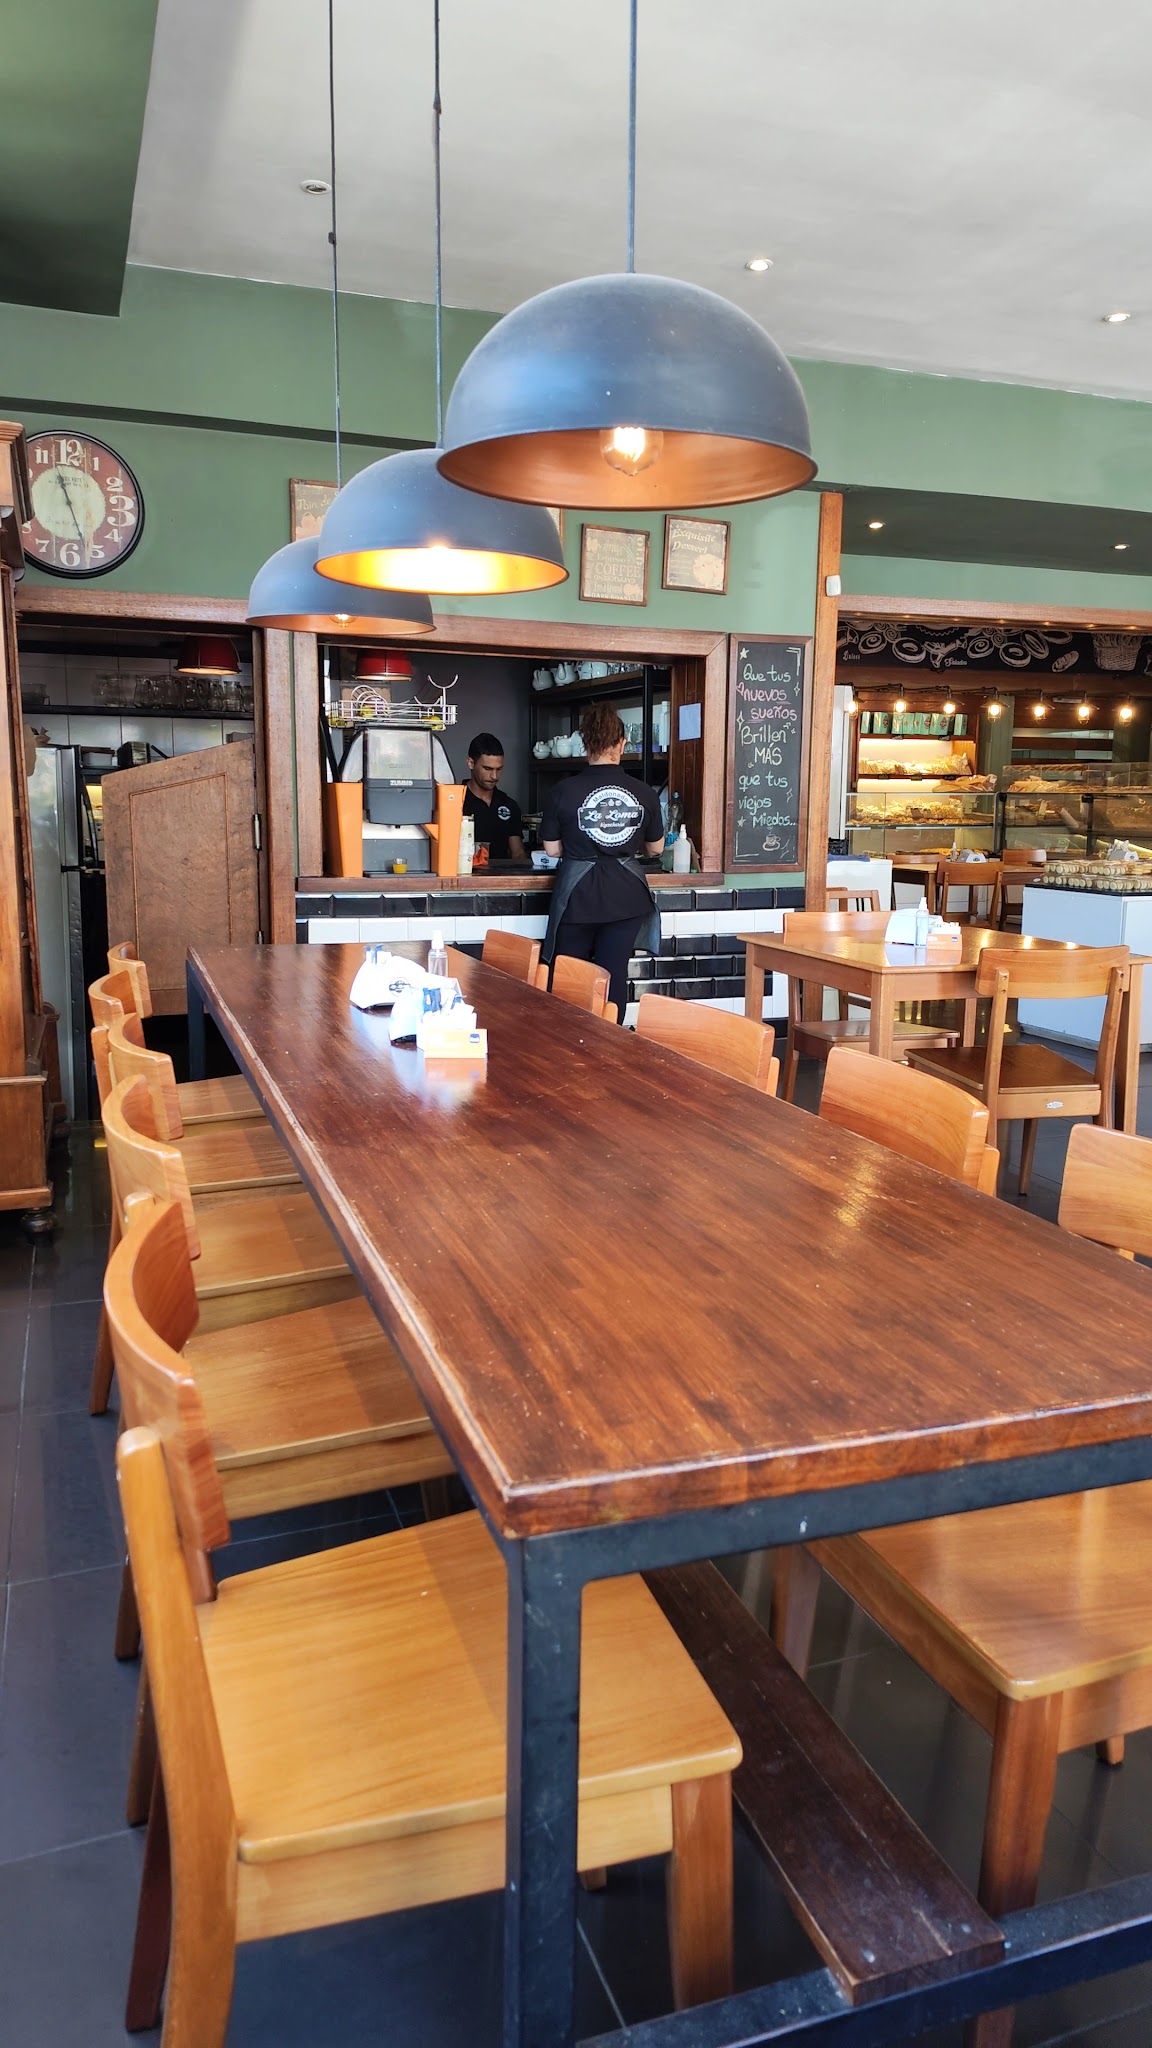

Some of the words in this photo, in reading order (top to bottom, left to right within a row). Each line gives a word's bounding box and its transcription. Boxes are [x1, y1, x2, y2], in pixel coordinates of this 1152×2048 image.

[34, 448, 48, 464] 11
[55, 439, 82, 466] 12
[92, 456, 99, 471] 1
[106, 476, 123, 492] 2
[107, 495, 136, 527] 3
[104, 529, 123, 543] 4
[671, 528, 716, 543] Exquisite
[35, 538, 50, 553] 7
[91, 544, 105, 559] 5
[671, 540, 708, 554] Dessert
[60, 542, 80, 567] 6
[595, 562, 641, 578] COFFEE
[743, 663, 766, 682] Que
[767, 664, 791, 682] tus
[744, 689, 787, 702] nuevos
[750, 705, 798, 722] sueños
[741, 724, 787, 746] Brillen
[754, 742, 782, 766] MÁS
[738, 774, 760, 792] que
[765, 771, 788, 788] tus
[592, 792, 629, 803] Maldonado
[738, 796, 772, 815] viejos
[584, 810, 602, 822] La
[605, 809, 639, 822] Loma
